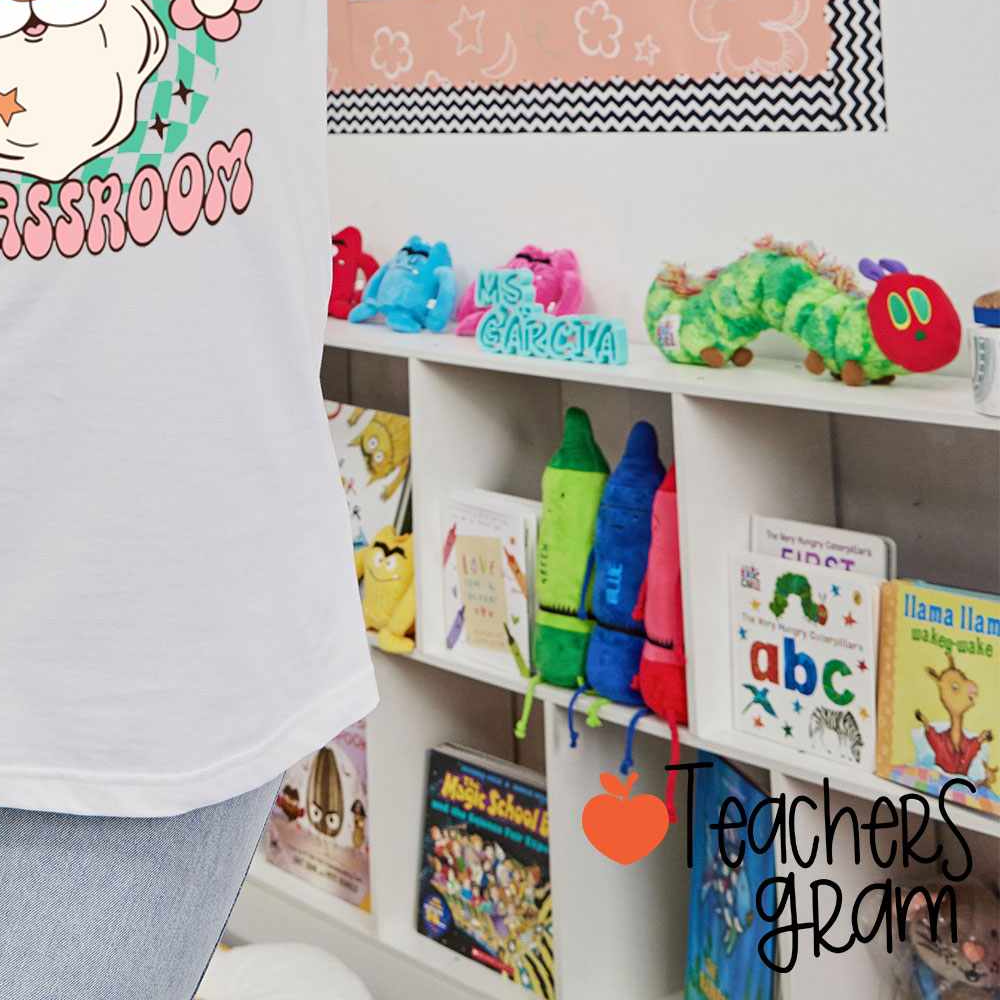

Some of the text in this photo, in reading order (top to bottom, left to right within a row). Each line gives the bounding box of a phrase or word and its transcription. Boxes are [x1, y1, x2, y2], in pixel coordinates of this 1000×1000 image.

[479, 313, 618, 365] GARCIA
[904, 593, 1000, 638] llama llam
[911, 626, 994, 658] wakey-wake
[750, 636, 856, 706] abc
[440, 770, 487, 811] Magic
[486, 787, 541, 833] School
